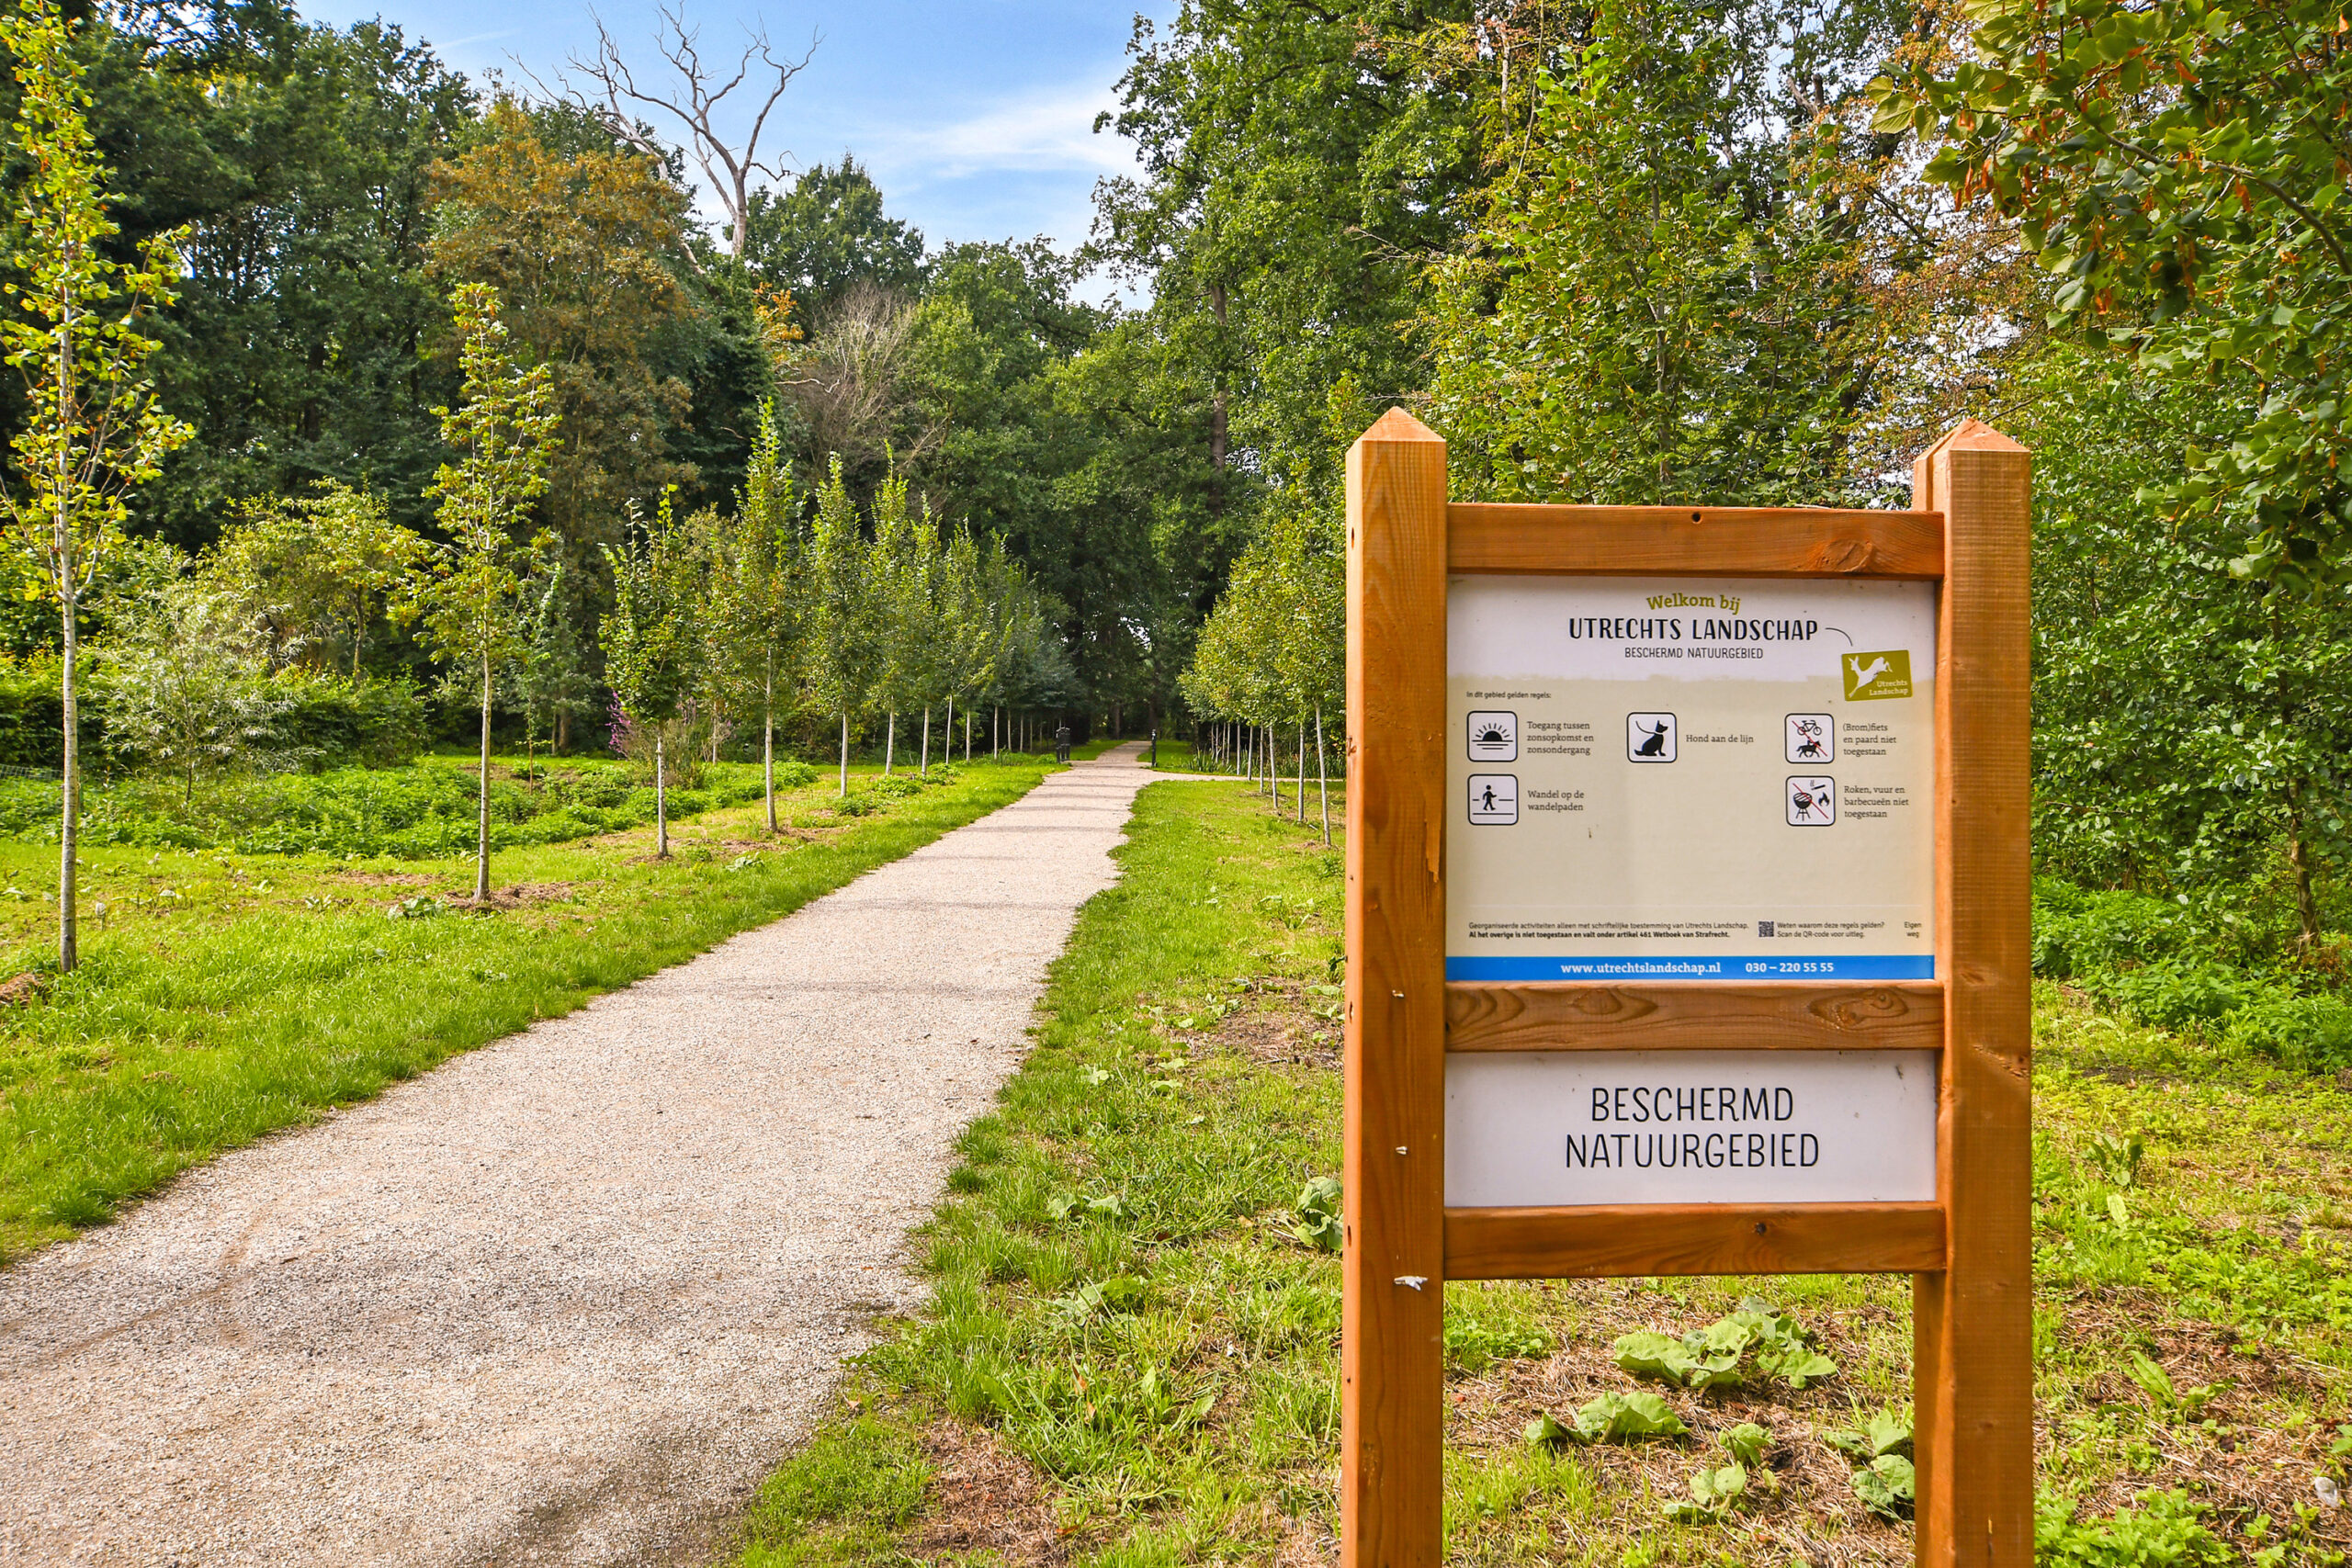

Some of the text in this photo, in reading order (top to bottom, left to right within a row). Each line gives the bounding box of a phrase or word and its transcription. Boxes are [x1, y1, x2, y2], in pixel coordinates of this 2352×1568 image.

[1646, 592, 1740, 615] Welkom bij
[1568, 617, 1818, 641] UTRECHTS LANDSCHAP
[1624, 647, 1764, 659] BESCHERMD NATUURGEBIED
[1876, 679, 1908, 688] Utrechts
[1868, 687, 1909, 696] Landschap
[1527, 721, 1590, 731] Toegang tussen
[1843, 723, 1888, 732] (Brom)fiets
[1527, 733, 1582, 744] zonsopkomst
[1686, 734, 1709, 743] Hond
[1727, 734, 1738, 743] de
[1739, 733, 1754, 745] lijn
[1843, 735, 1897, 746] en paard niet
[1527, 746, 1590, 756] zonsondergang
[1843, 748, 1887, 757] toegestaan
[1527, 789, 1584, 800] Wandel op de
[1844, 785, 1871, 795] Roken,
[1844, 797, 1909, 807] barbecueën niet
[1528, 802, 1584, 813] wandelpaden
[1844, 810, 1888, 819] toegestaan
[1468, 921, 1519, 931] Georganiseerde
[1630, 921, 1671, 931] toestemming
[1713, 921, 1749, 931] Landschap.
[1839, 921, 1860, 930] regels
[1860, 921, 1884, 930] gelden?
[1904, 921, 1922, 930] Eigen
[1489, 931, 1514, 939] overige
[1536, 931, 1573, 939] toegestaan
[1803, 931, 1829, 939] QR-code
[1560, 961, 1722, 976] www.utrechtslandschap.nl
[1745, 962, 1768, 973] 030
[1779, 962, 1802, 973] 220
[1803, 962, 1818, 973] 55
[1819, 962, 1835, 973] 55
[1590, 1087, 1794, 1122] BESCHERMD
[1566, 1133, 1820, 1168] NATUURGEBIED
